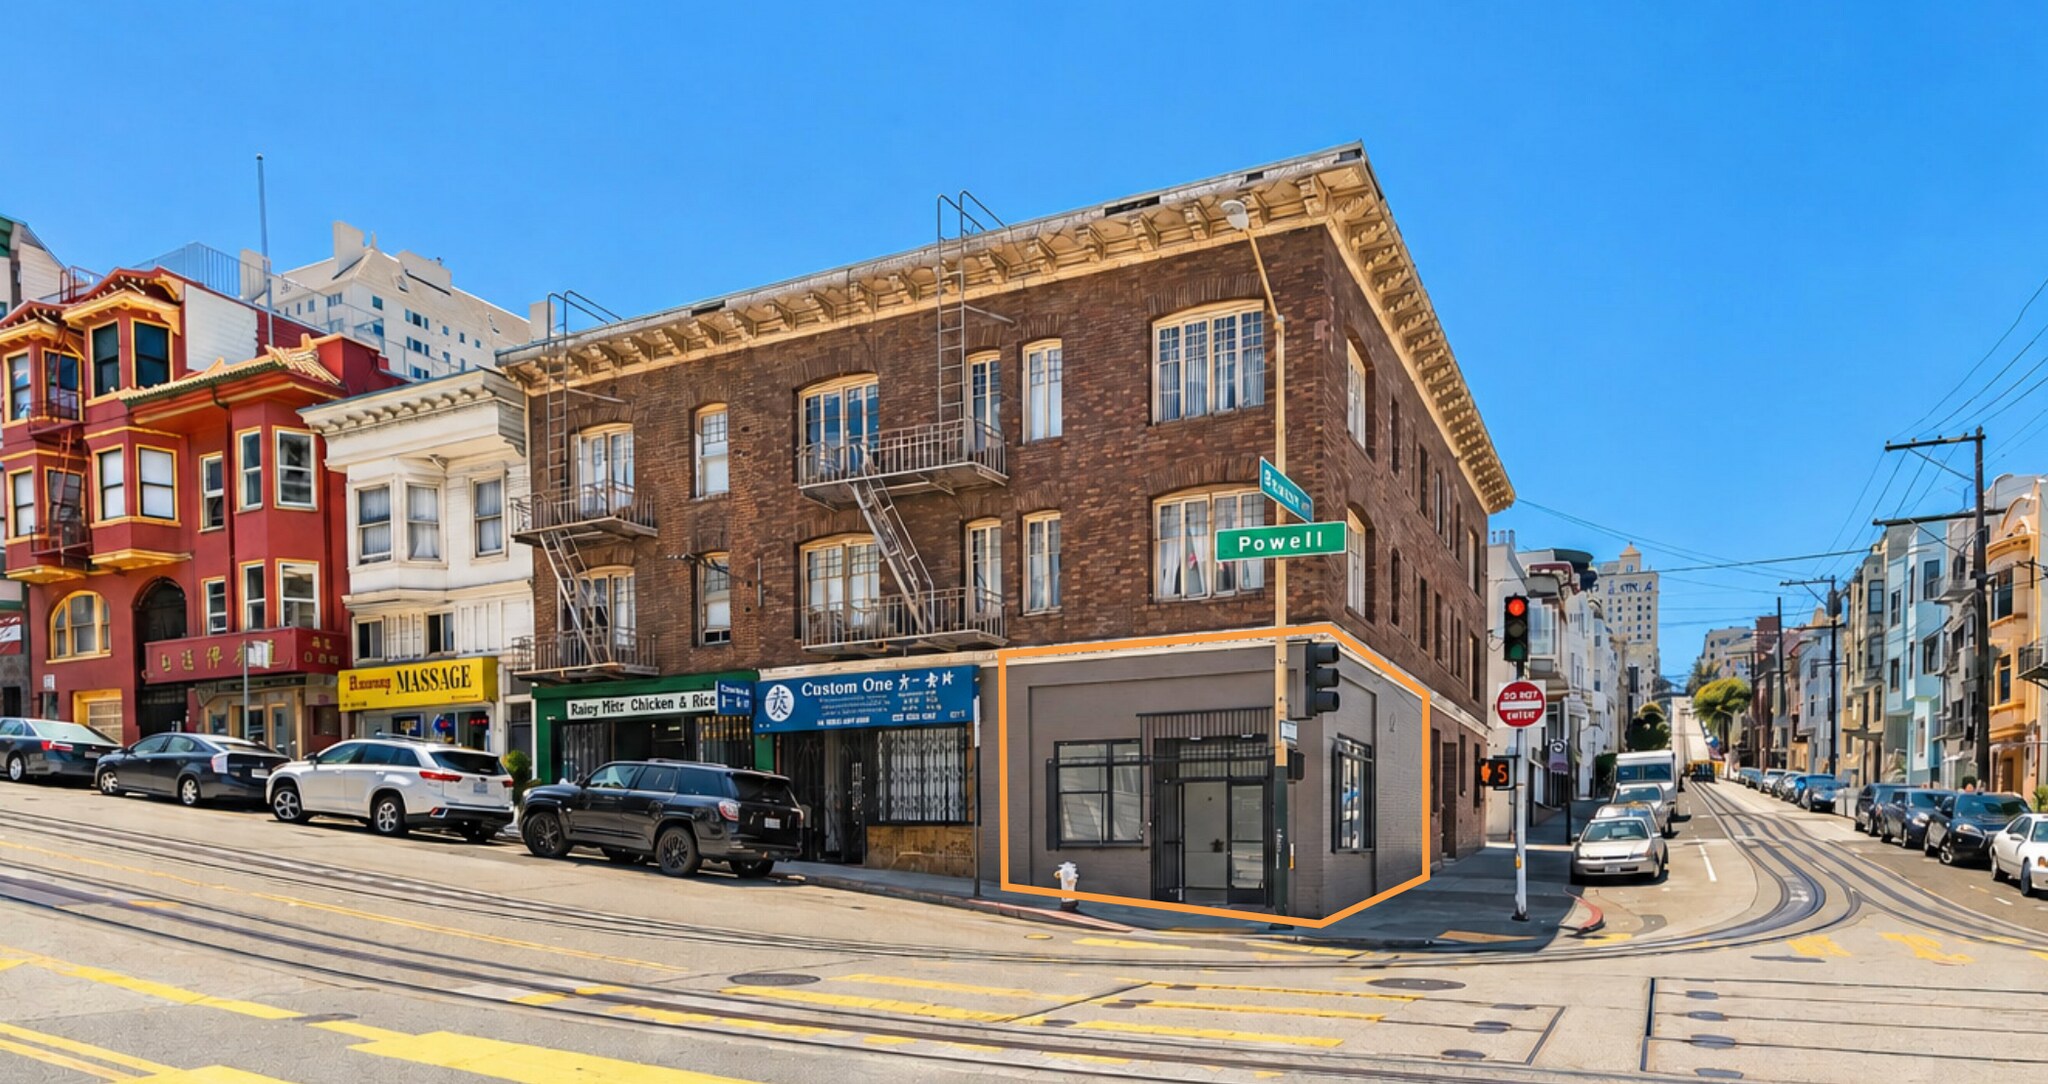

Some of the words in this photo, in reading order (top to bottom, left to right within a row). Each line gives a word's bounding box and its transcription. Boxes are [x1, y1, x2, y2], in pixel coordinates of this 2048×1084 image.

[1239, 531, 1322, 552] Powell
[397, 665, 471, 693] MASSAGE
[801, 681, 857, 696] Custom
[863, 678, 893, 692] One
[631, 698, 674, 712] Chicken
[679, 697, 687, 709] &
[693, 694, 716, 707] Rice
